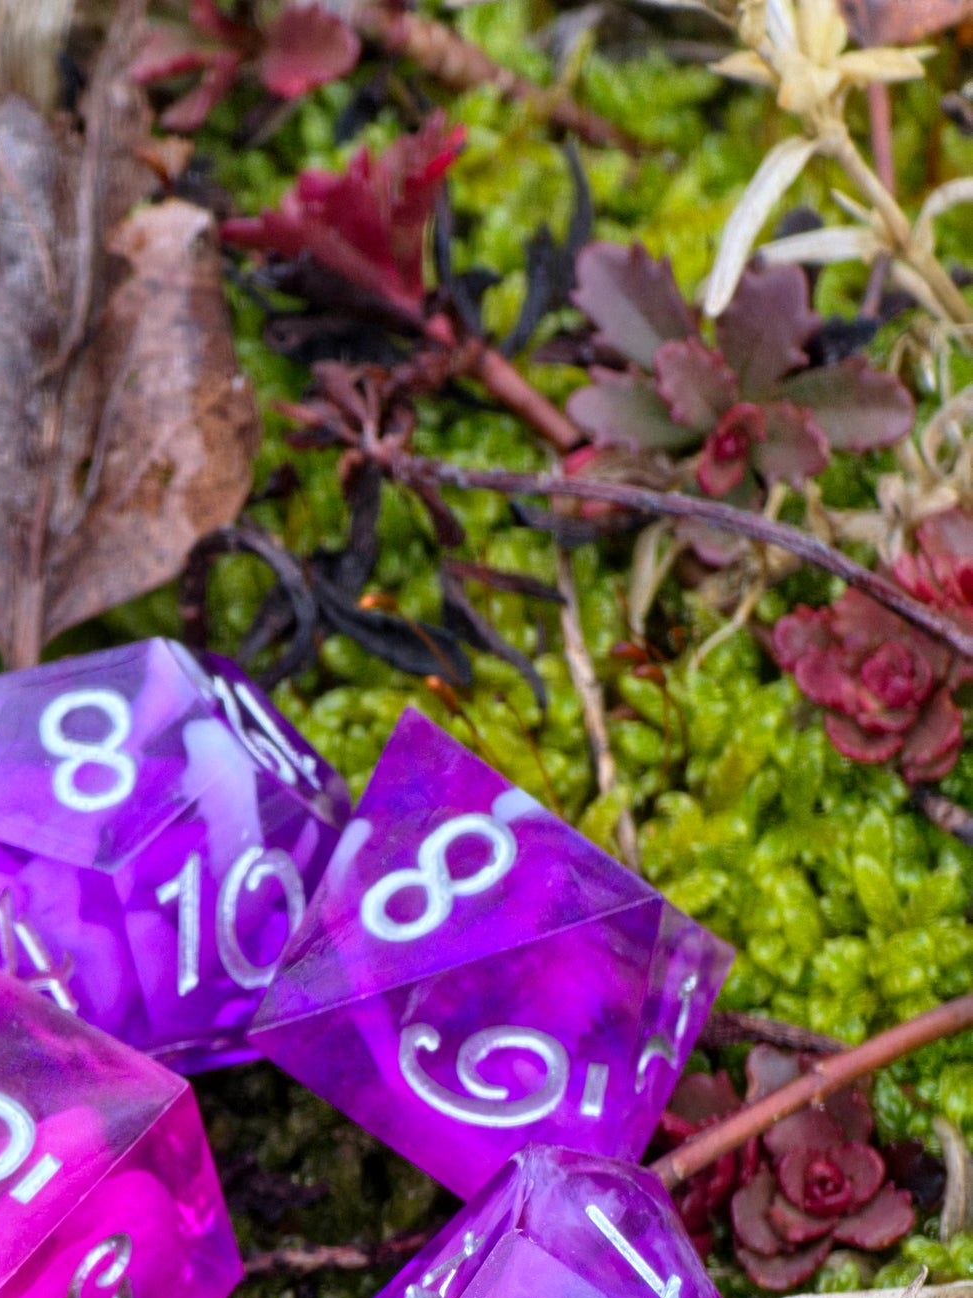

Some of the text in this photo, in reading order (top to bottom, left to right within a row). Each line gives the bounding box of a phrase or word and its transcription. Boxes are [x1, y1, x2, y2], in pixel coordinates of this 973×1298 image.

[39, 688, 135, 812] 8
[156, 845, 305, 996] 10
[360, 812, 517, 942] 8
